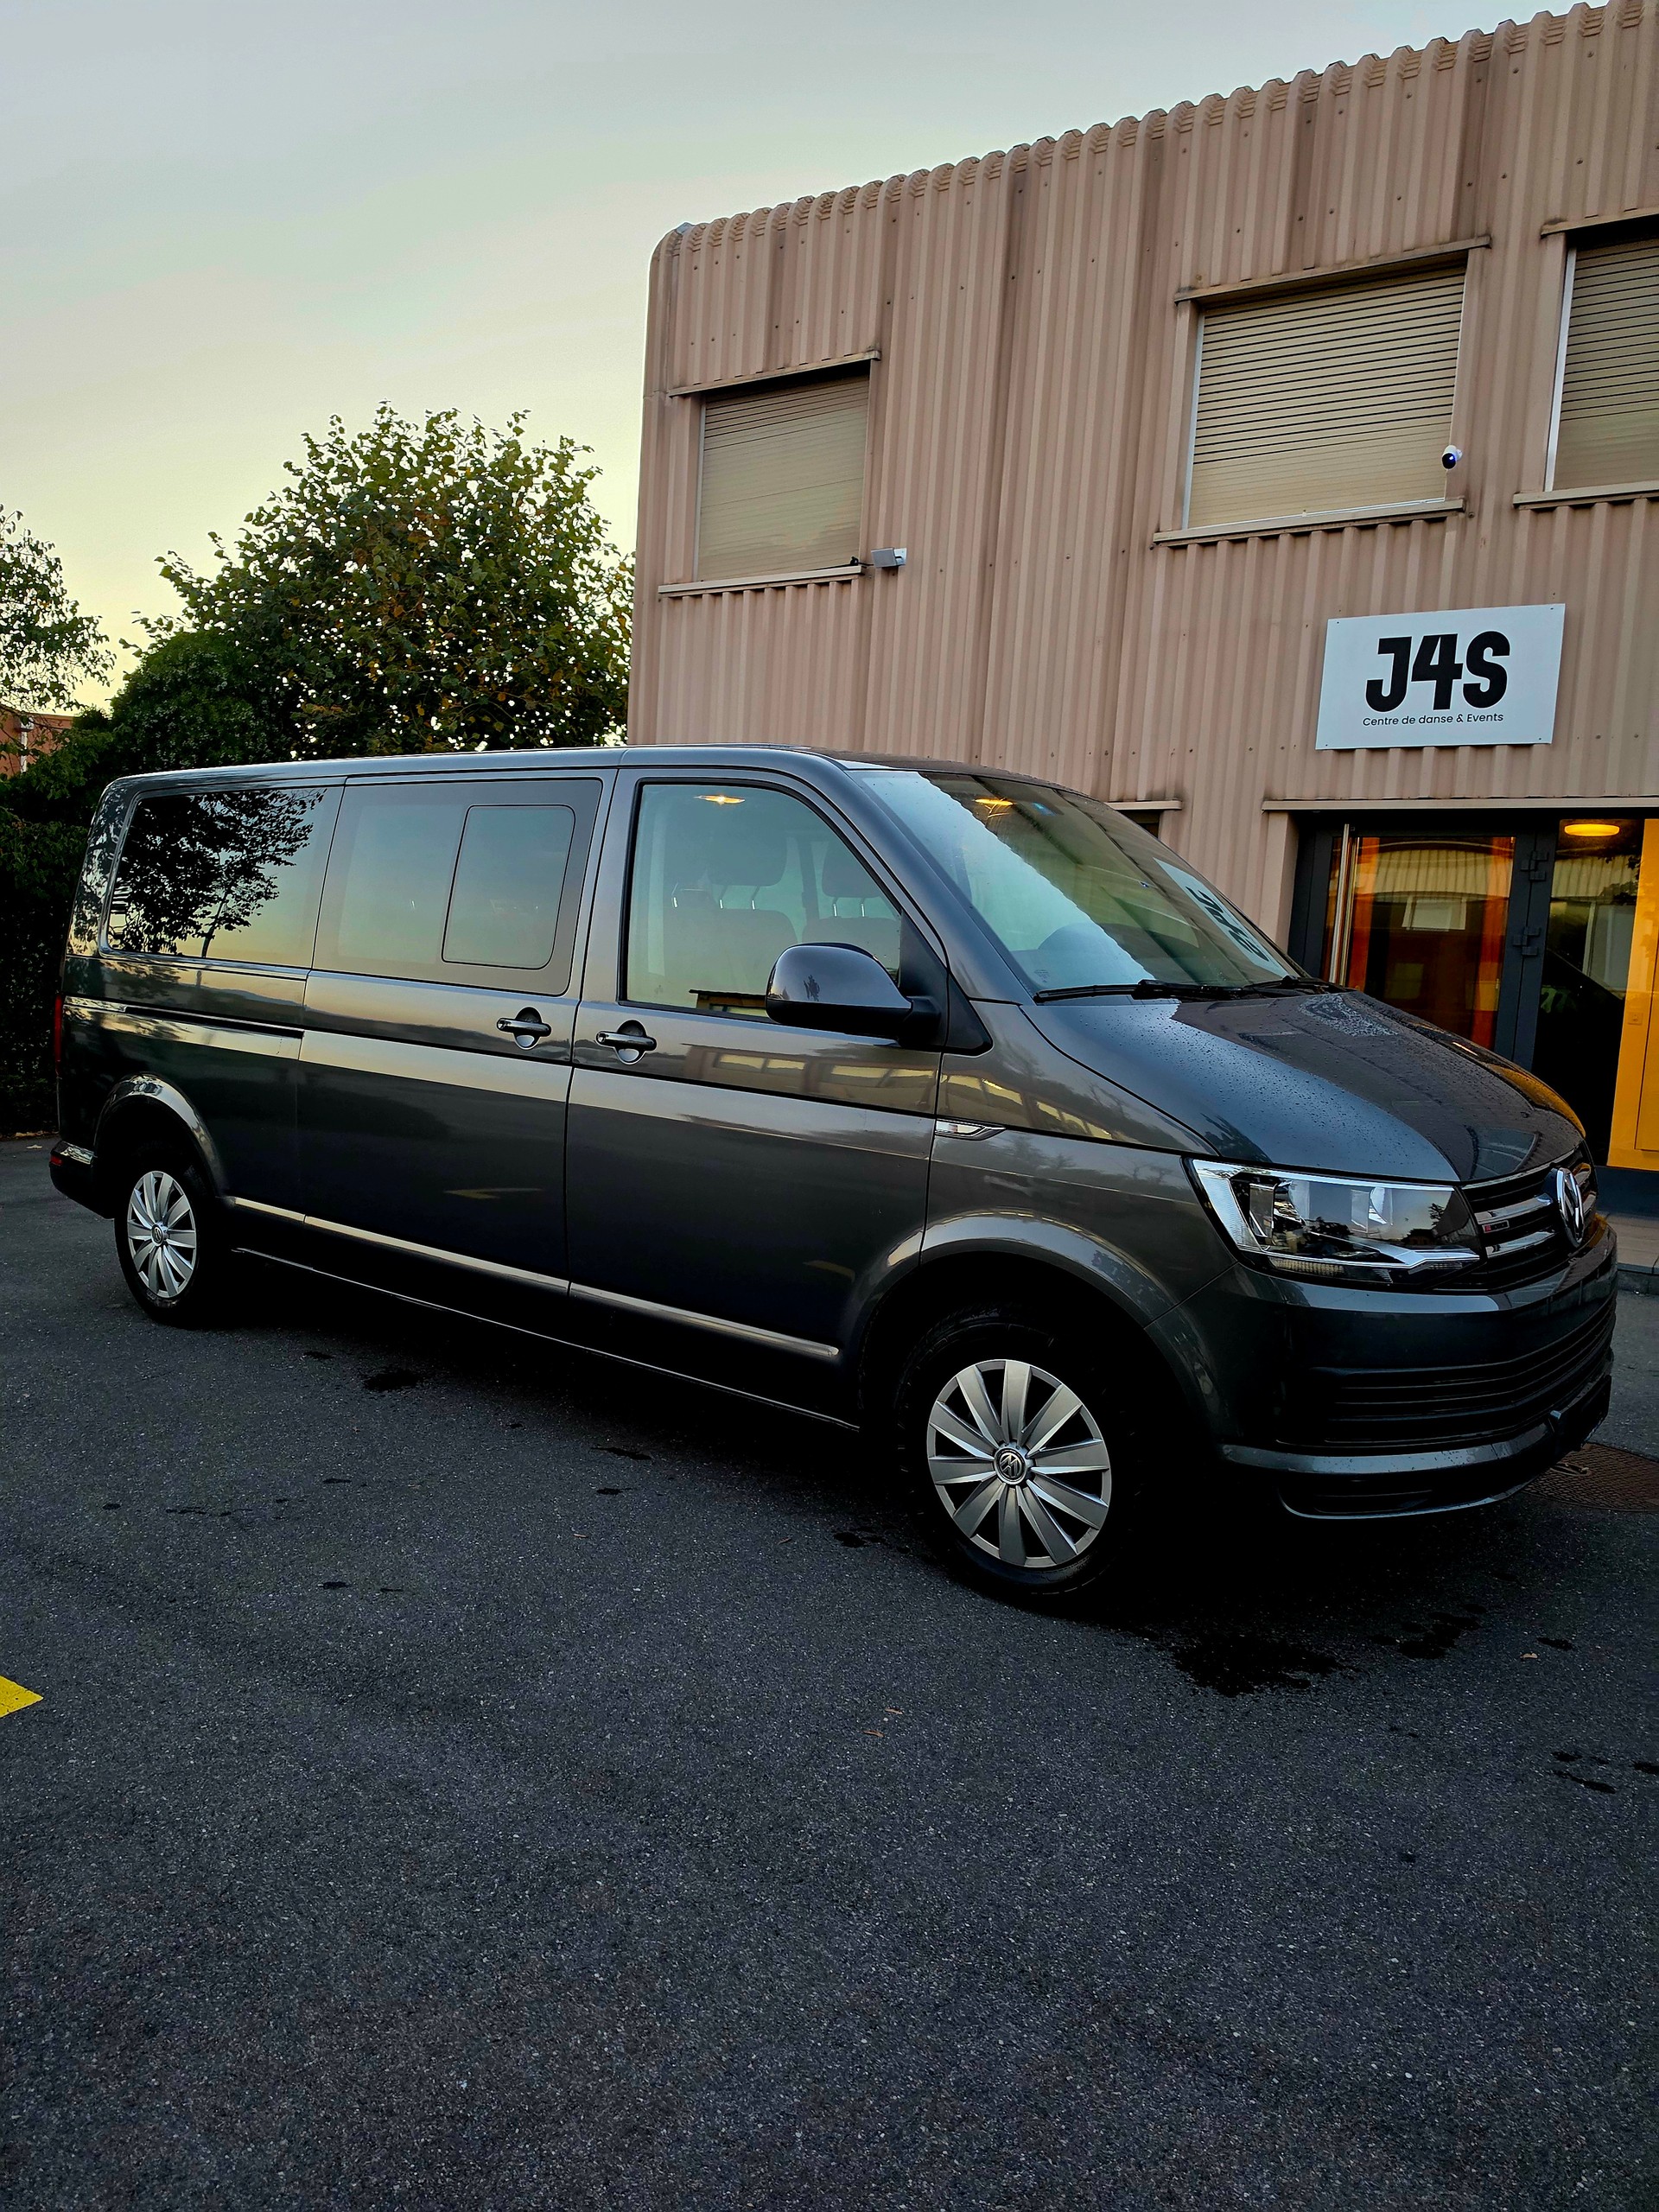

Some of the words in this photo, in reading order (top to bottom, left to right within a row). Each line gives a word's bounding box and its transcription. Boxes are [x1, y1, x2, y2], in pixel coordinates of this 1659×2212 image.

[1365, 630, 1510, 713] J4S
[1363, 716, 1399, 726] Centre
[1402, 715, 1416, 725] de
[1418, 715, 1453, 724] danse
[1456, 713, 1464, 722] &
[1466, 713, 1504, 722] Events
